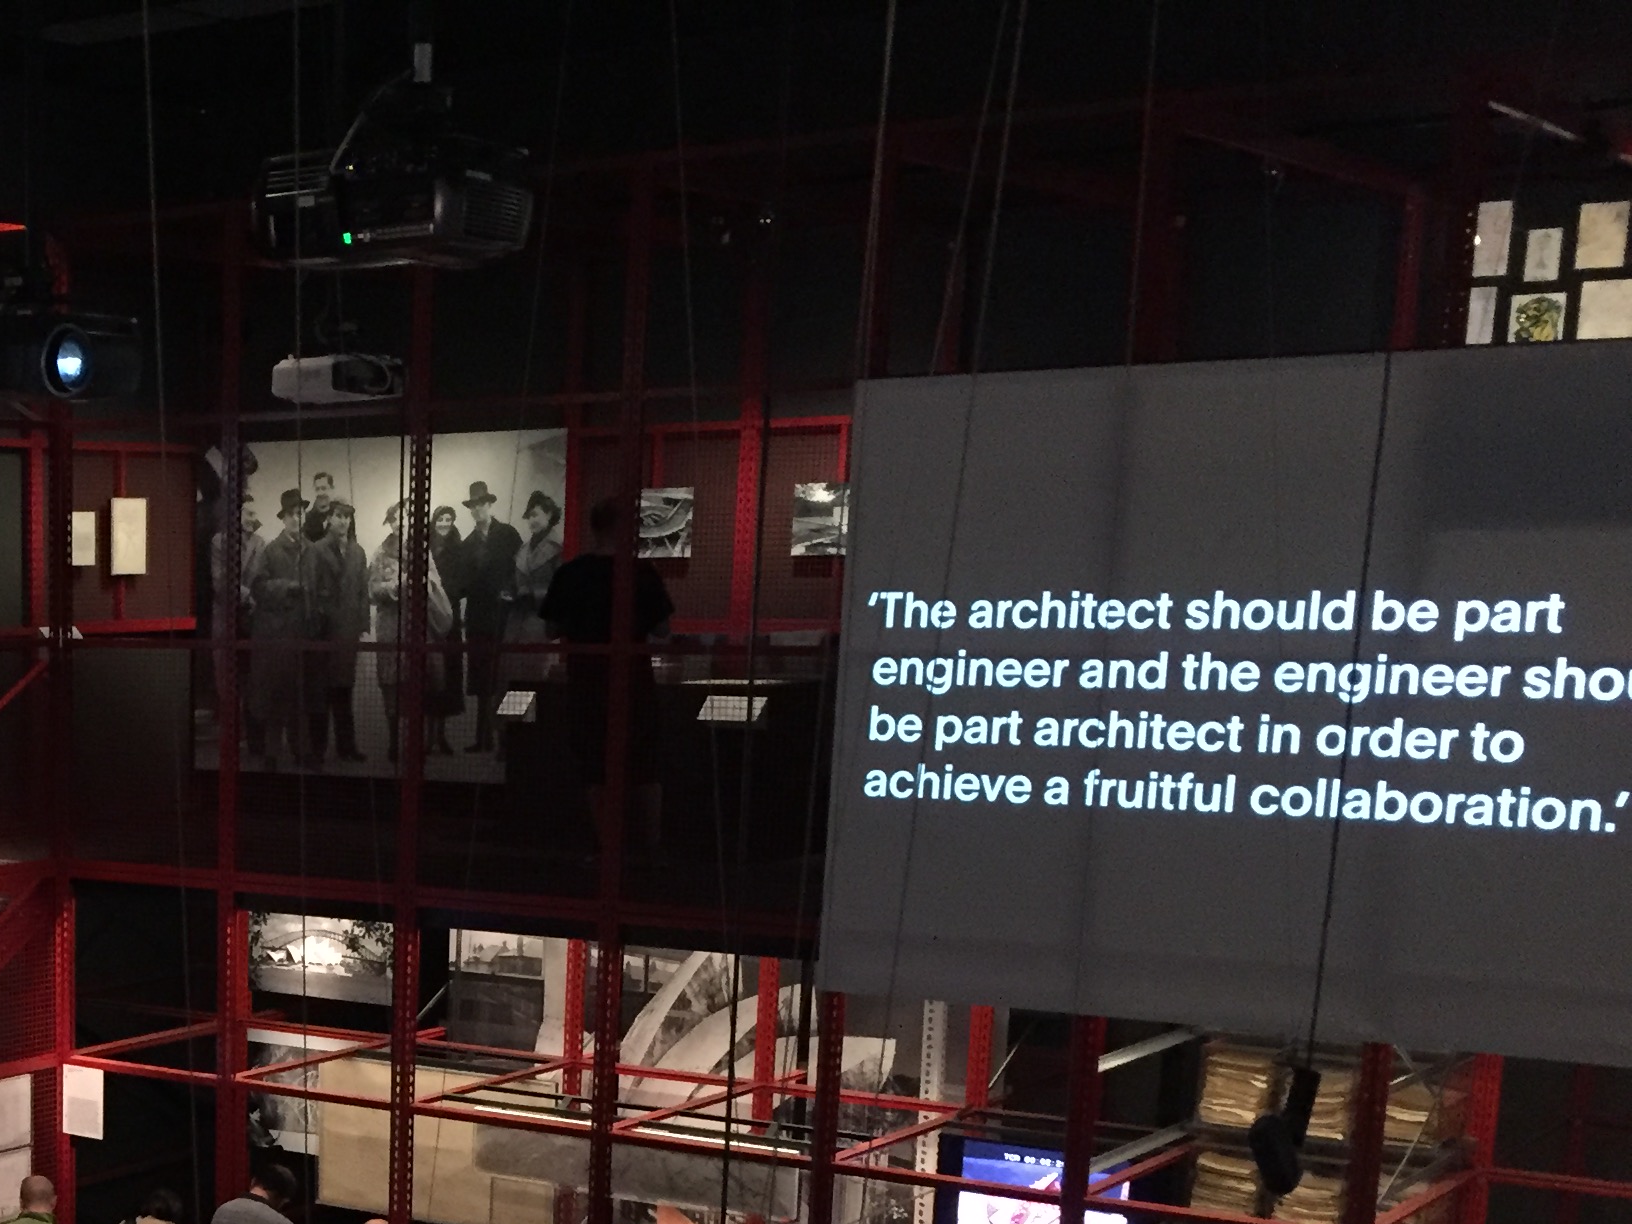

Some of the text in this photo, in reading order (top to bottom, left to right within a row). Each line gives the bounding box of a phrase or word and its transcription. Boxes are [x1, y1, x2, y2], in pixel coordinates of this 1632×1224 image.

[968, 590, 1174, 631] architect
[1184, 589, 1357, 632] should
[1371, 589, 1441, 633] be
[1453, 593, 1566, 642] part
[872, 648, 1632, 704] engineer and the engineer sho
[868, 704, 1525, 764] be part architect in order to
[863, 763, 1033, 804] achieve
[1043, 776, 1070, 806] a
[1083, 768, 1237, 813] fruitful
